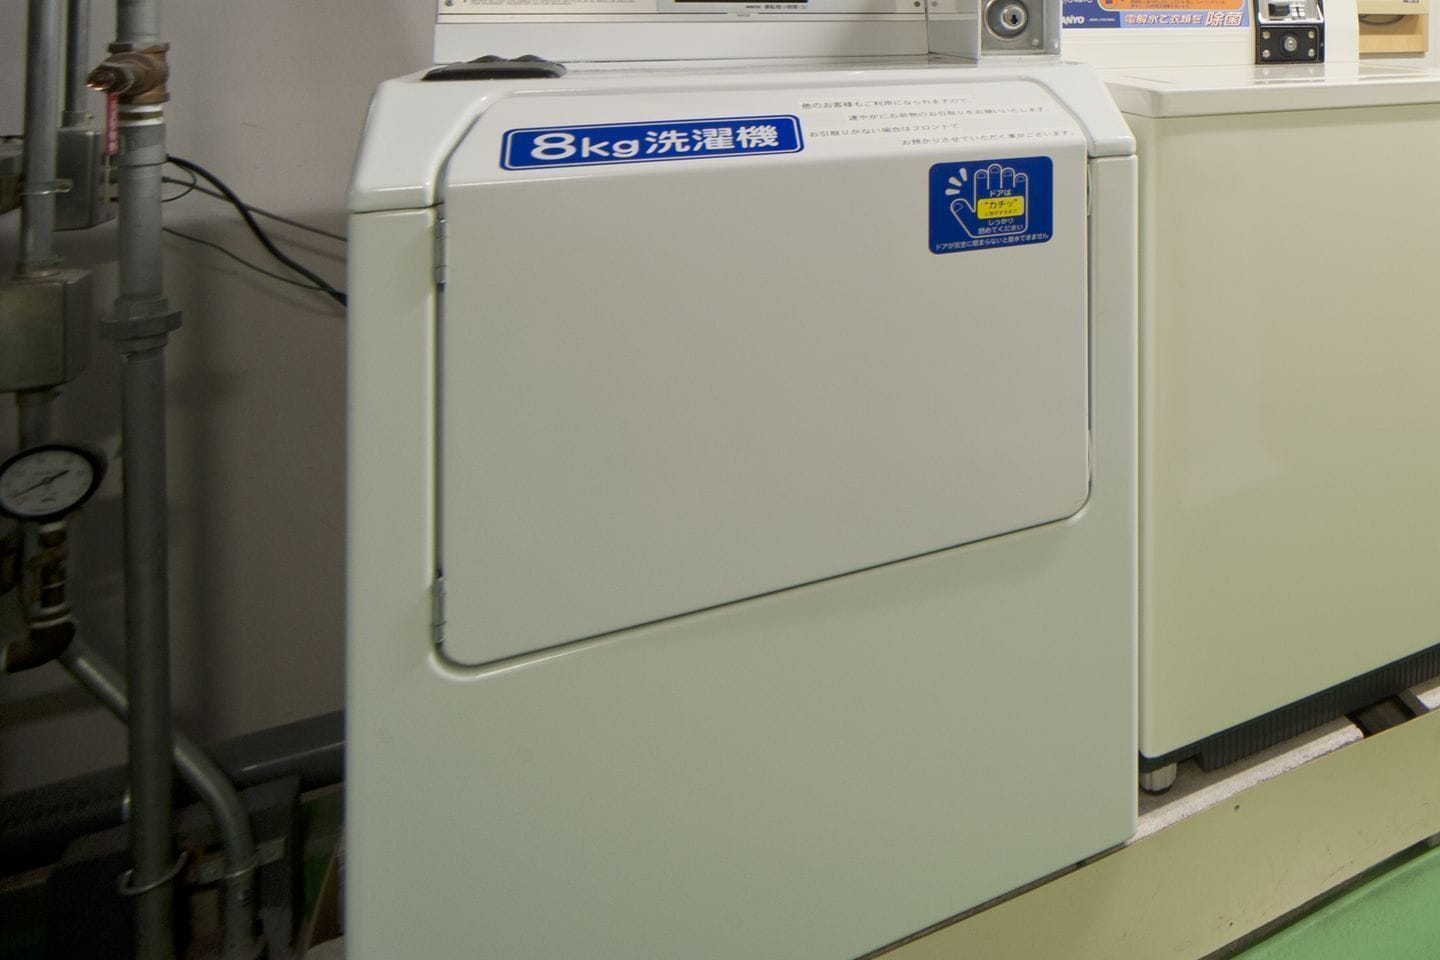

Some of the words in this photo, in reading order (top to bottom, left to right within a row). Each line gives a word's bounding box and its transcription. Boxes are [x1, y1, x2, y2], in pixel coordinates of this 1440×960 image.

[1060, 15, 1085, 25] ANYO
[1124, 14, 1203, 26] 電解水で衣類を
[1204, 11, 1243, 26] 除菌
[530, 124, 778, 160] 8kg洗濯機
[990, 189, 1012, 197] ドアは
